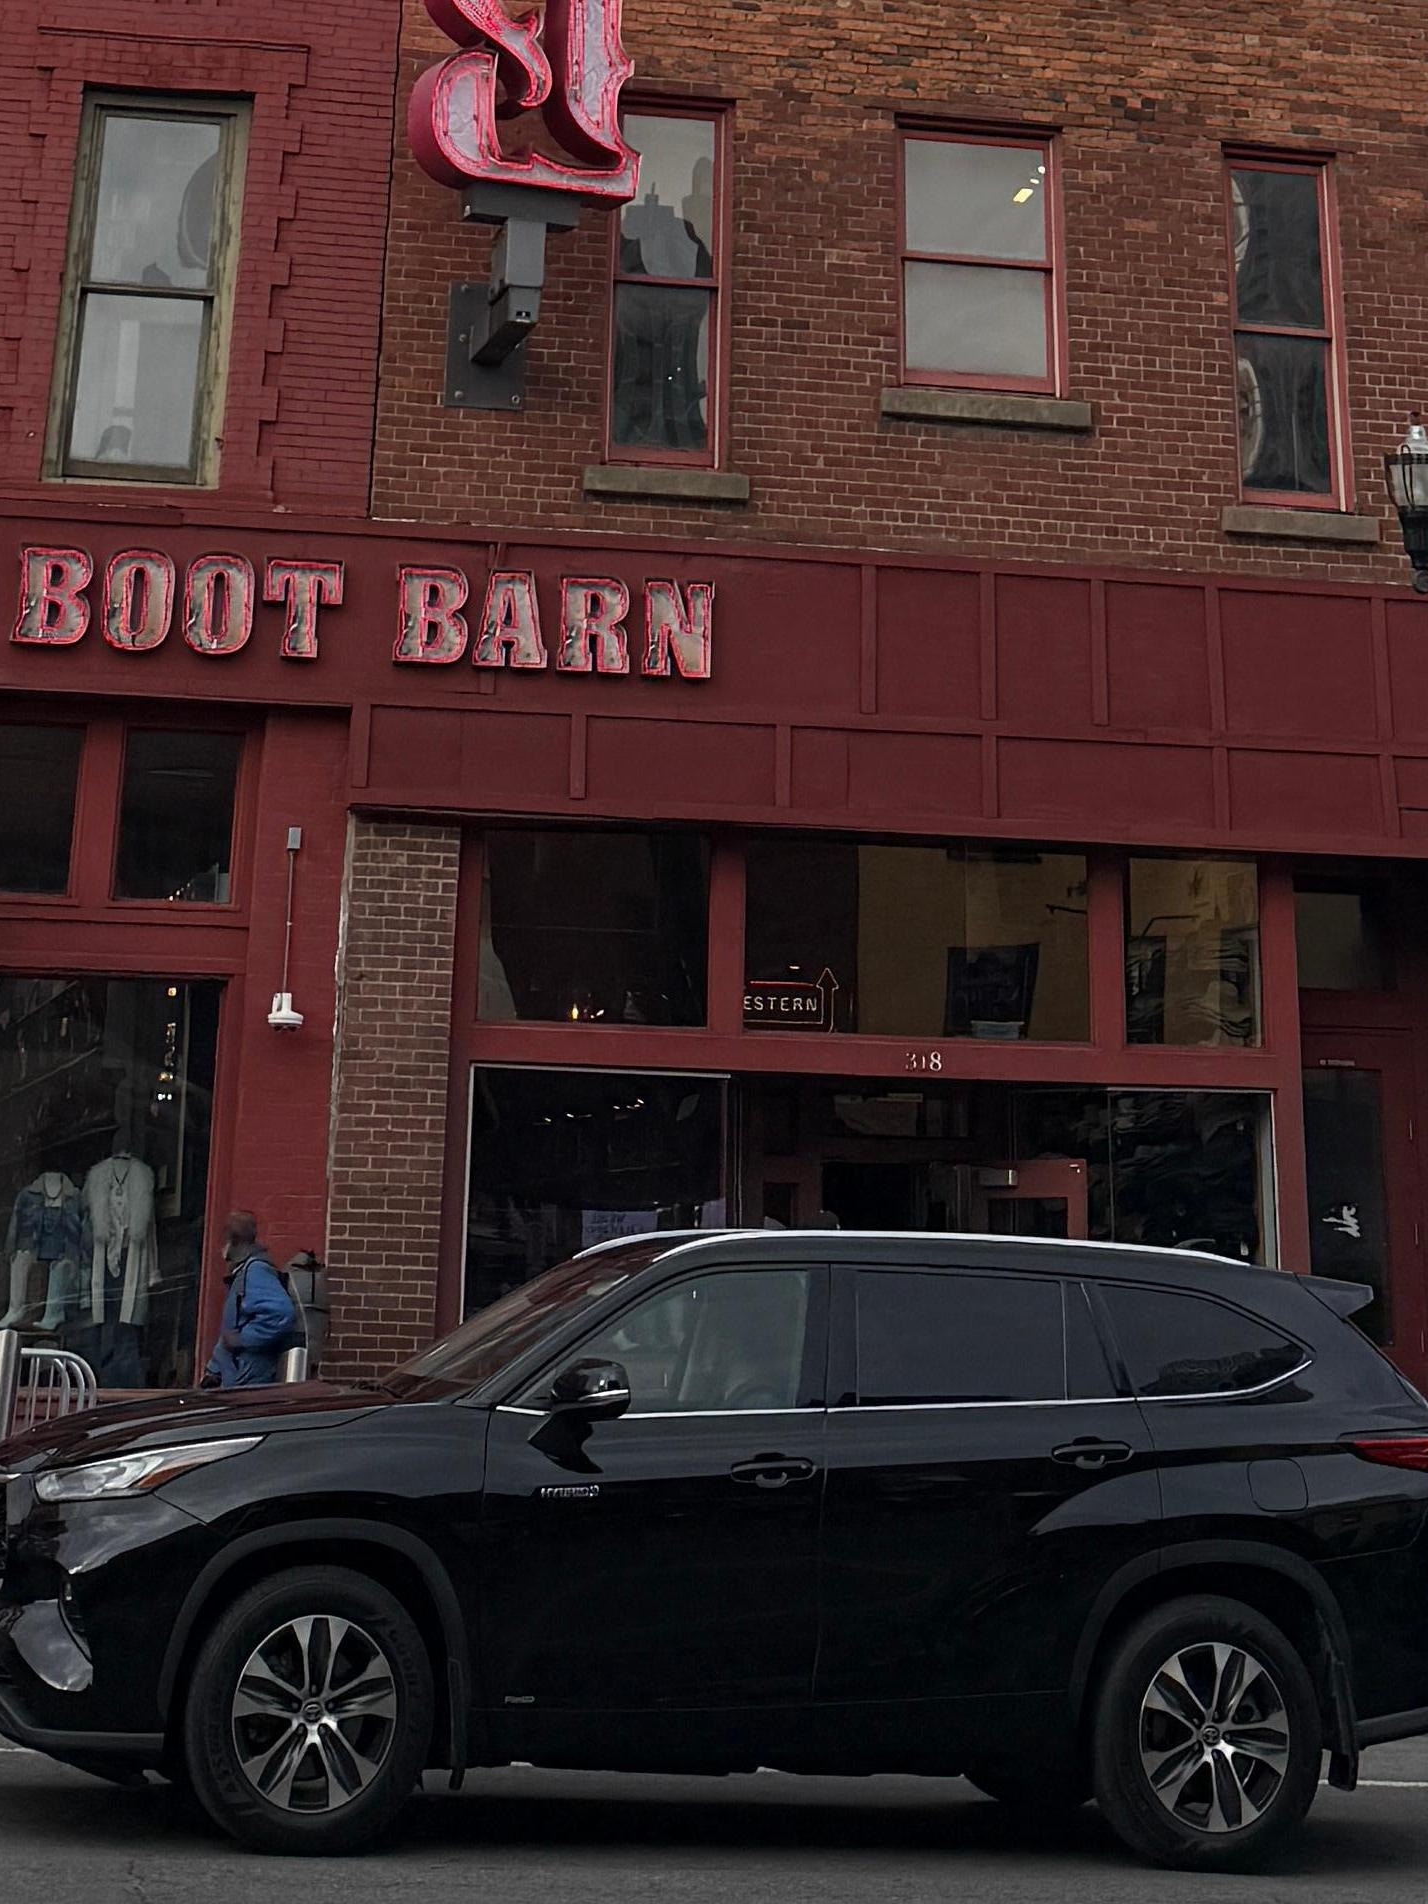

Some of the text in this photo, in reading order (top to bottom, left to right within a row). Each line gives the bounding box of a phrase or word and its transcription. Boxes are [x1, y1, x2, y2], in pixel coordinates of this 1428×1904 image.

[9, 542, 716, 679] BOOT BARN
[744, 995, 817, 1011] ESTERN
